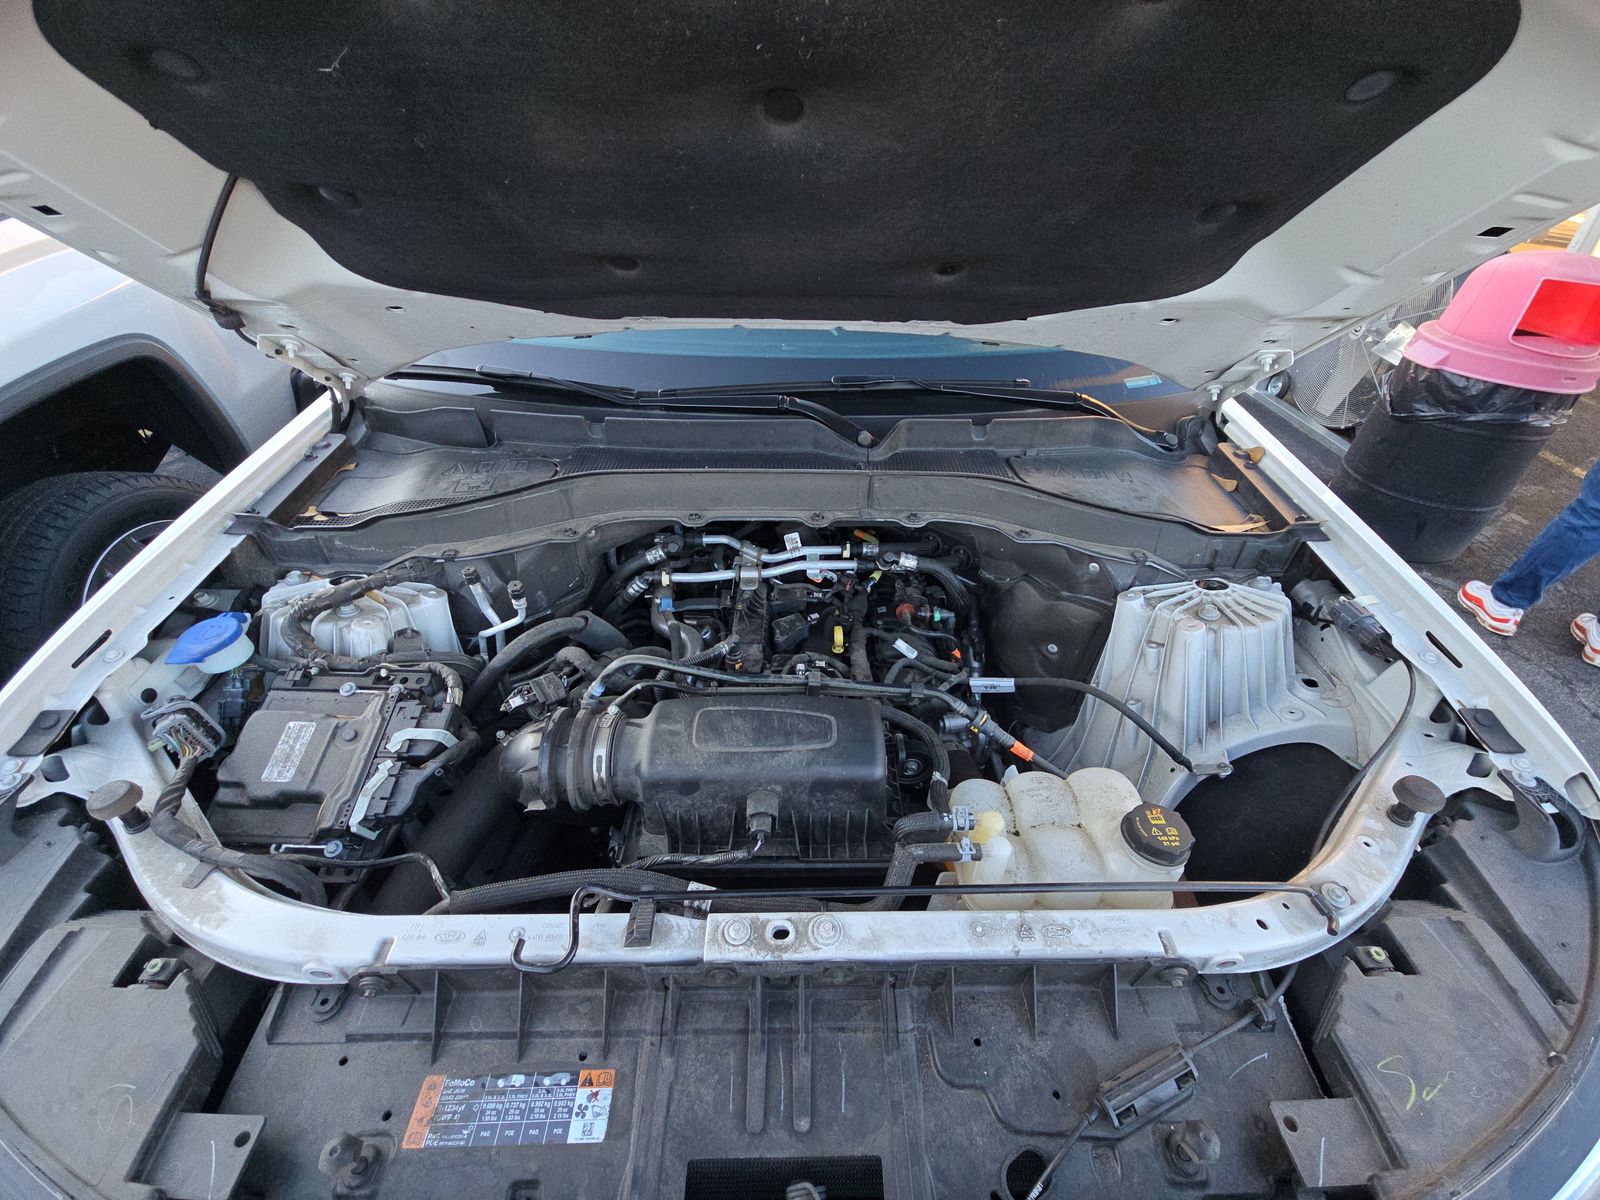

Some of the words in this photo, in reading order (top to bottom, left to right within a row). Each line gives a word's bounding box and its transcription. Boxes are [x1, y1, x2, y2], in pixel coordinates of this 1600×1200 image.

[444, 1078, 475, 1087] FoMoCo
[496, 1102, 503, 1110] kg
[519, 1102, 526, 1110] kg
[545, 1101, 551, 1109] kg
[567, 1100, 574, 1108] kg
